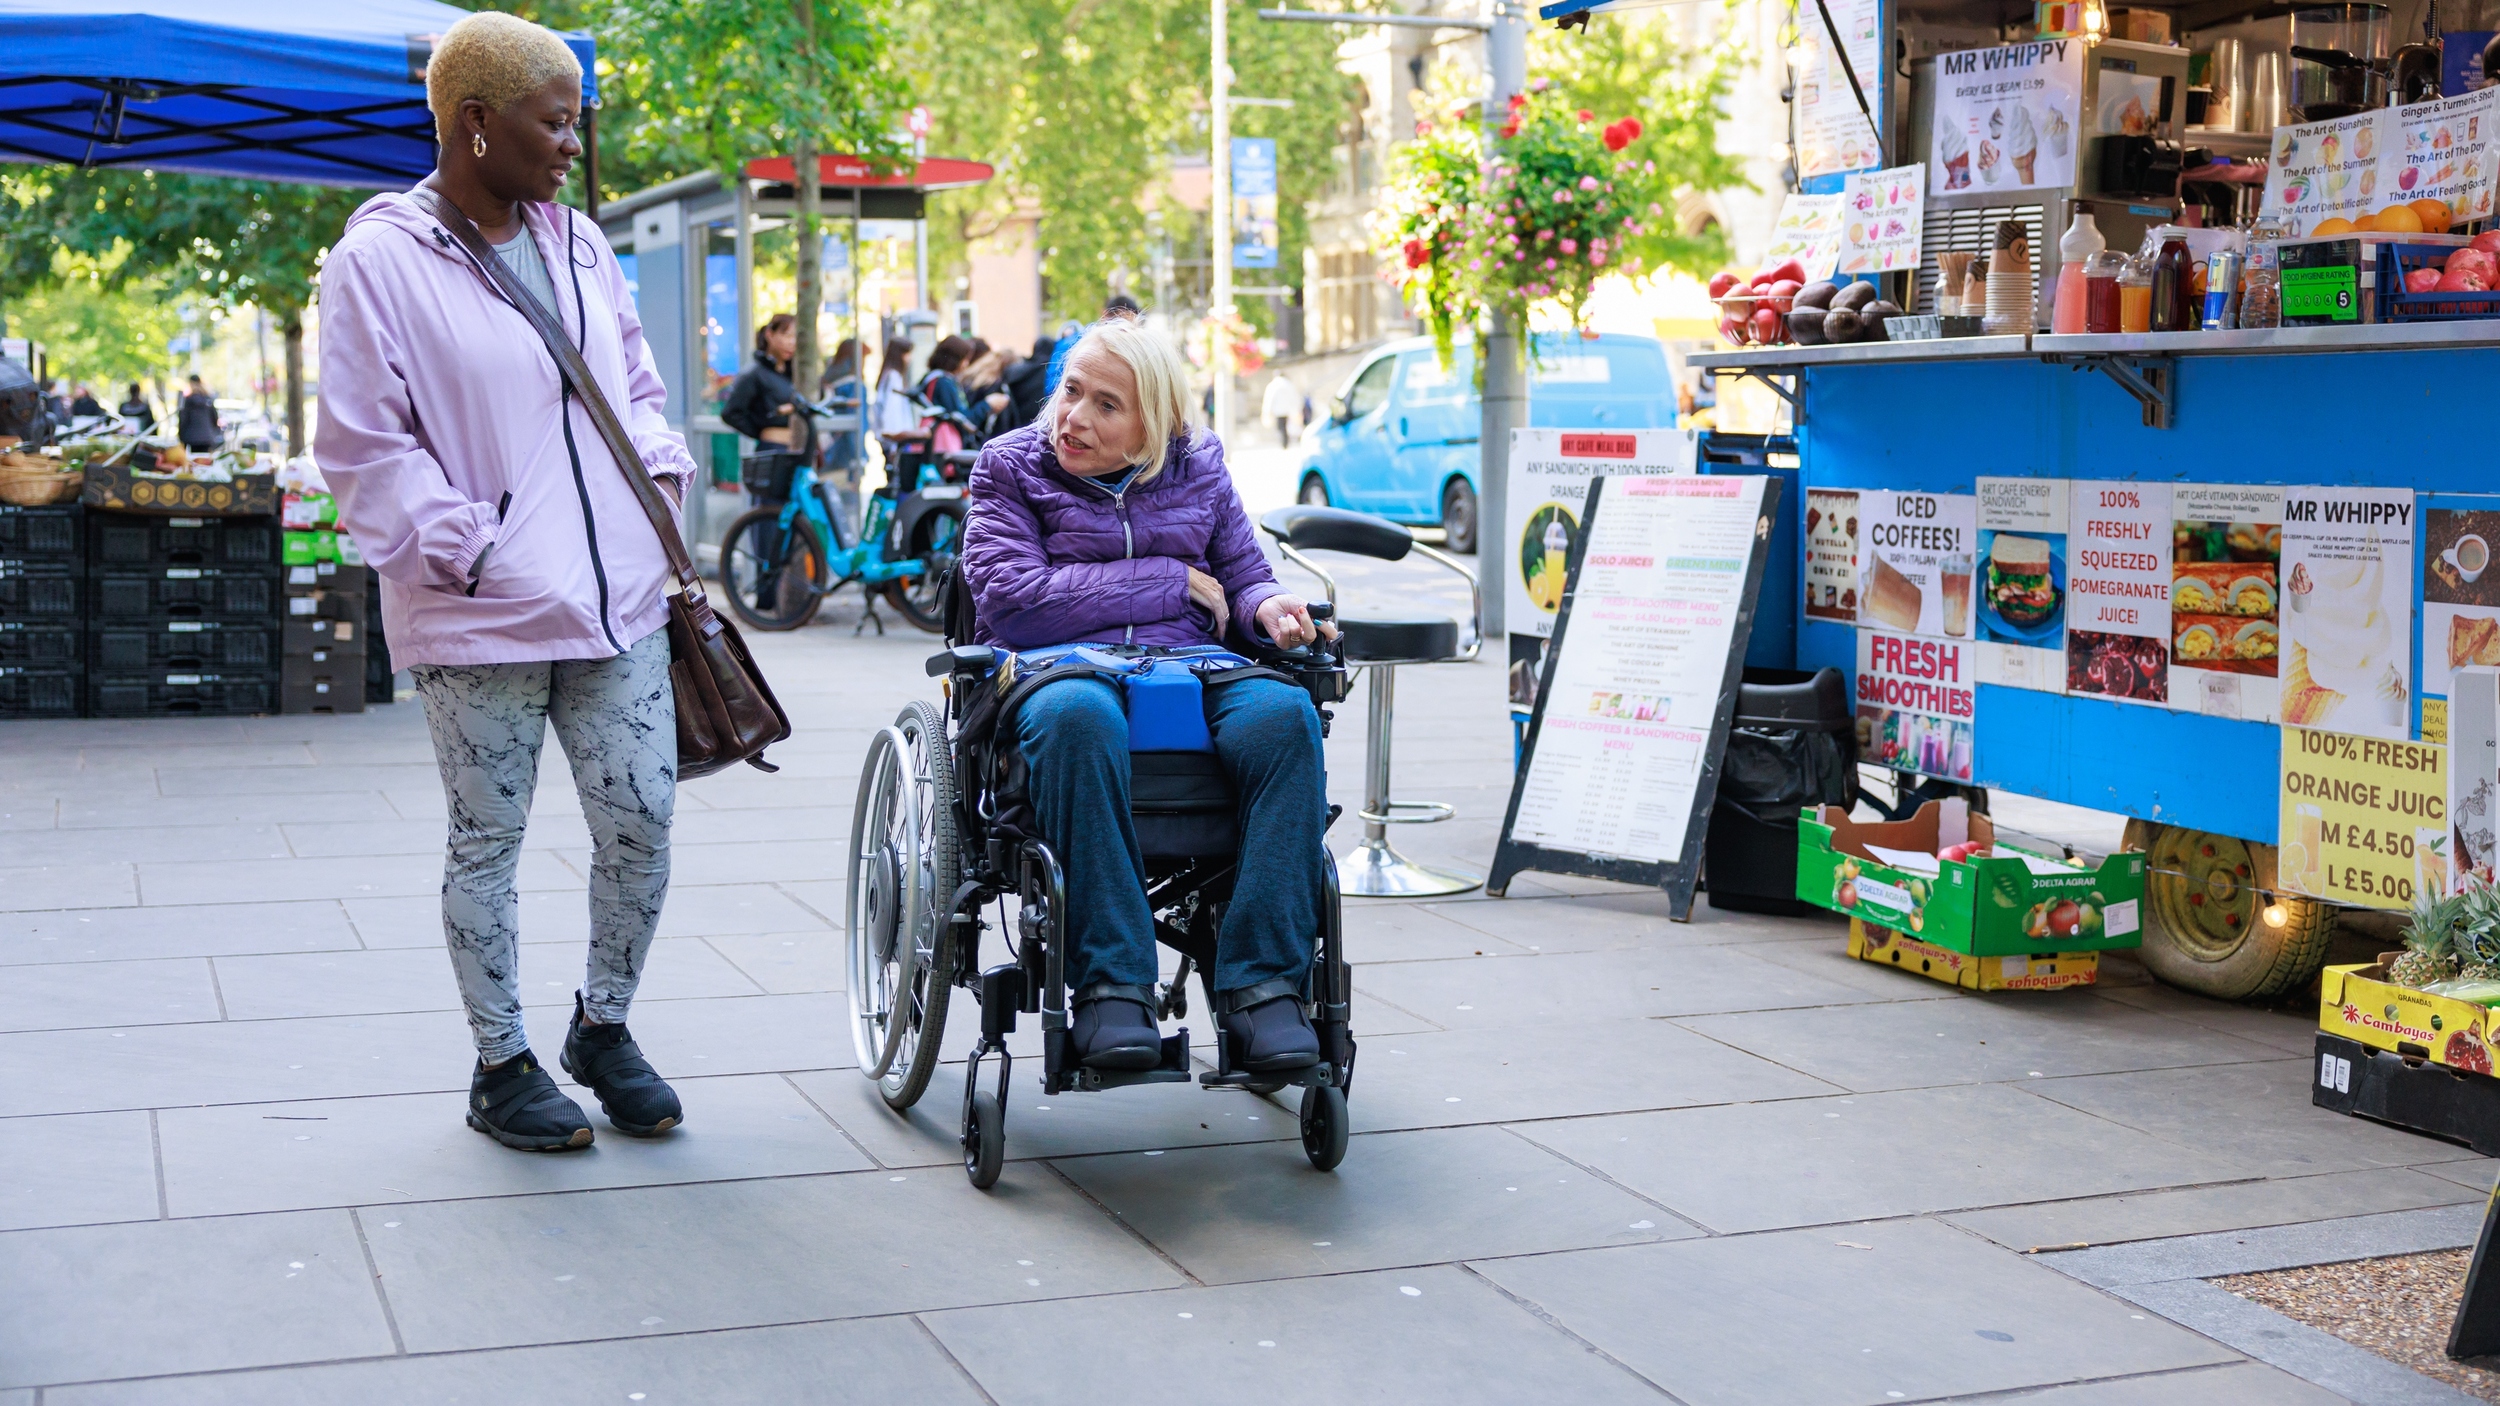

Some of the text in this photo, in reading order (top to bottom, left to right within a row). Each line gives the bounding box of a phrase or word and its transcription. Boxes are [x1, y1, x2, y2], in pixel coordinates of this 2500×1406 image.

[1945, 40, 2068, 76] MR WHIPPY
[1981, 84, 1992, 94] ICE
[1995, 82, 2021, 94] CREAM
[2402, 89, 2494, 118] Ginger & Turmeric Shot
[2296, 116, 2373, 138] The Art of Sunshine
[2406, 141, 2486, 164] The Art of The Day
[2283, 156, 2376, 178] The Art of the Summer
[1860, 177, 1872, 185] The
[1873, 175, 1882, 183] Art
[1883, 174, 1888, 182] of
[2389, 176, 2487, 202] The Art of Feeling Good
[1862, 211, 1874, 219] The
[1876, 210, 1884, 218] Art
[1891, 207, 1908, 217] Energy
[2279, 206, 2293, 216] The
[2295, 204, 2309, 214] Art
[2310, 203, 2320, 212] of
[1867, 241, 1876, 249] Art
[1882, 239, 1900, 248] Feeling
[1901, 236, 1914, 245] Good
[2301, 272, 2324, 280] HYGIENE
[2340, 293, 2348, 306] 5
[1526, 462, 1542, 474] ANY
[1545, 462, 1590, 476] SANDWICH
[1592, 464, 1615, 476] WITH
[1617, 465, 1642, 475] 100%
[1550, 485, 1585, 499] ORANGE
[1982, 484, 2051, 497] ART CAFÉ ENERGY
[2176, 489, 2280, 503] ART CAFÉ VITAMIN SANDWICH
[1982, 496, 2026, 508] SANDWICH
[2099, 491, 2140, 508] 100%
[1896, 496, 1936, 518] ICED
[2285, 500, 2411, 525] MR WHIPPY
[2087, 520, 2152, 540] FRESHLY
[1815, 538, 1847, 547] NUTELLA
[1872, 524, 1960, 551] COFFEES!
[1590, 556, 1653, 567] SOLO JUICES
[1666, 558, 1741, 571] GREENS MENU
[1818, 553, 1847, 562] TOASTIE
[2081, 550, 2158, 571] SQUEEZED
[1814, 566, 1833, 575] ONLY
[1903, 574, 1926, 585] OFFEE
[2071, 578, 2168, 600] POMEGRANATE
[1602, 598, 1718, 612] FRESH SMOOTHIES MENU
[2097, 607, 2139, 624] JUICE!
[1872, 635, 1959, 683] FRESH
[1857, 674, 1972, 717] SMOOTHIES
[2424, 702, 2441, 711] ANY
[2424, 715, 2445, 725] DEAL
[1546, 718, 1576, 729] FRESH
[1579, 722, 1622, 733] COFFEES
[1633, 728, 1702, 742] SANDWICHES
[1603, 740, 1634, 750] MENU
[2300, 729, 2438, 774] 100% FRESH
[2286, 771, 2447, 821] ORANGE JUIC
[2321, 820, 2415, 859] M £4.50
[2040, 877, 2096, 888] DELTA AGRAR
[2328, 864, 2412, 901] L £5.00
[1898, 941, 1947, 962] Cambayas
[2007, 974, 2080, 989] Cambayas
[2398, 994, 2432, 1008] GRANADAS
[2362, 1014, 2435, 1042] Cambayas
